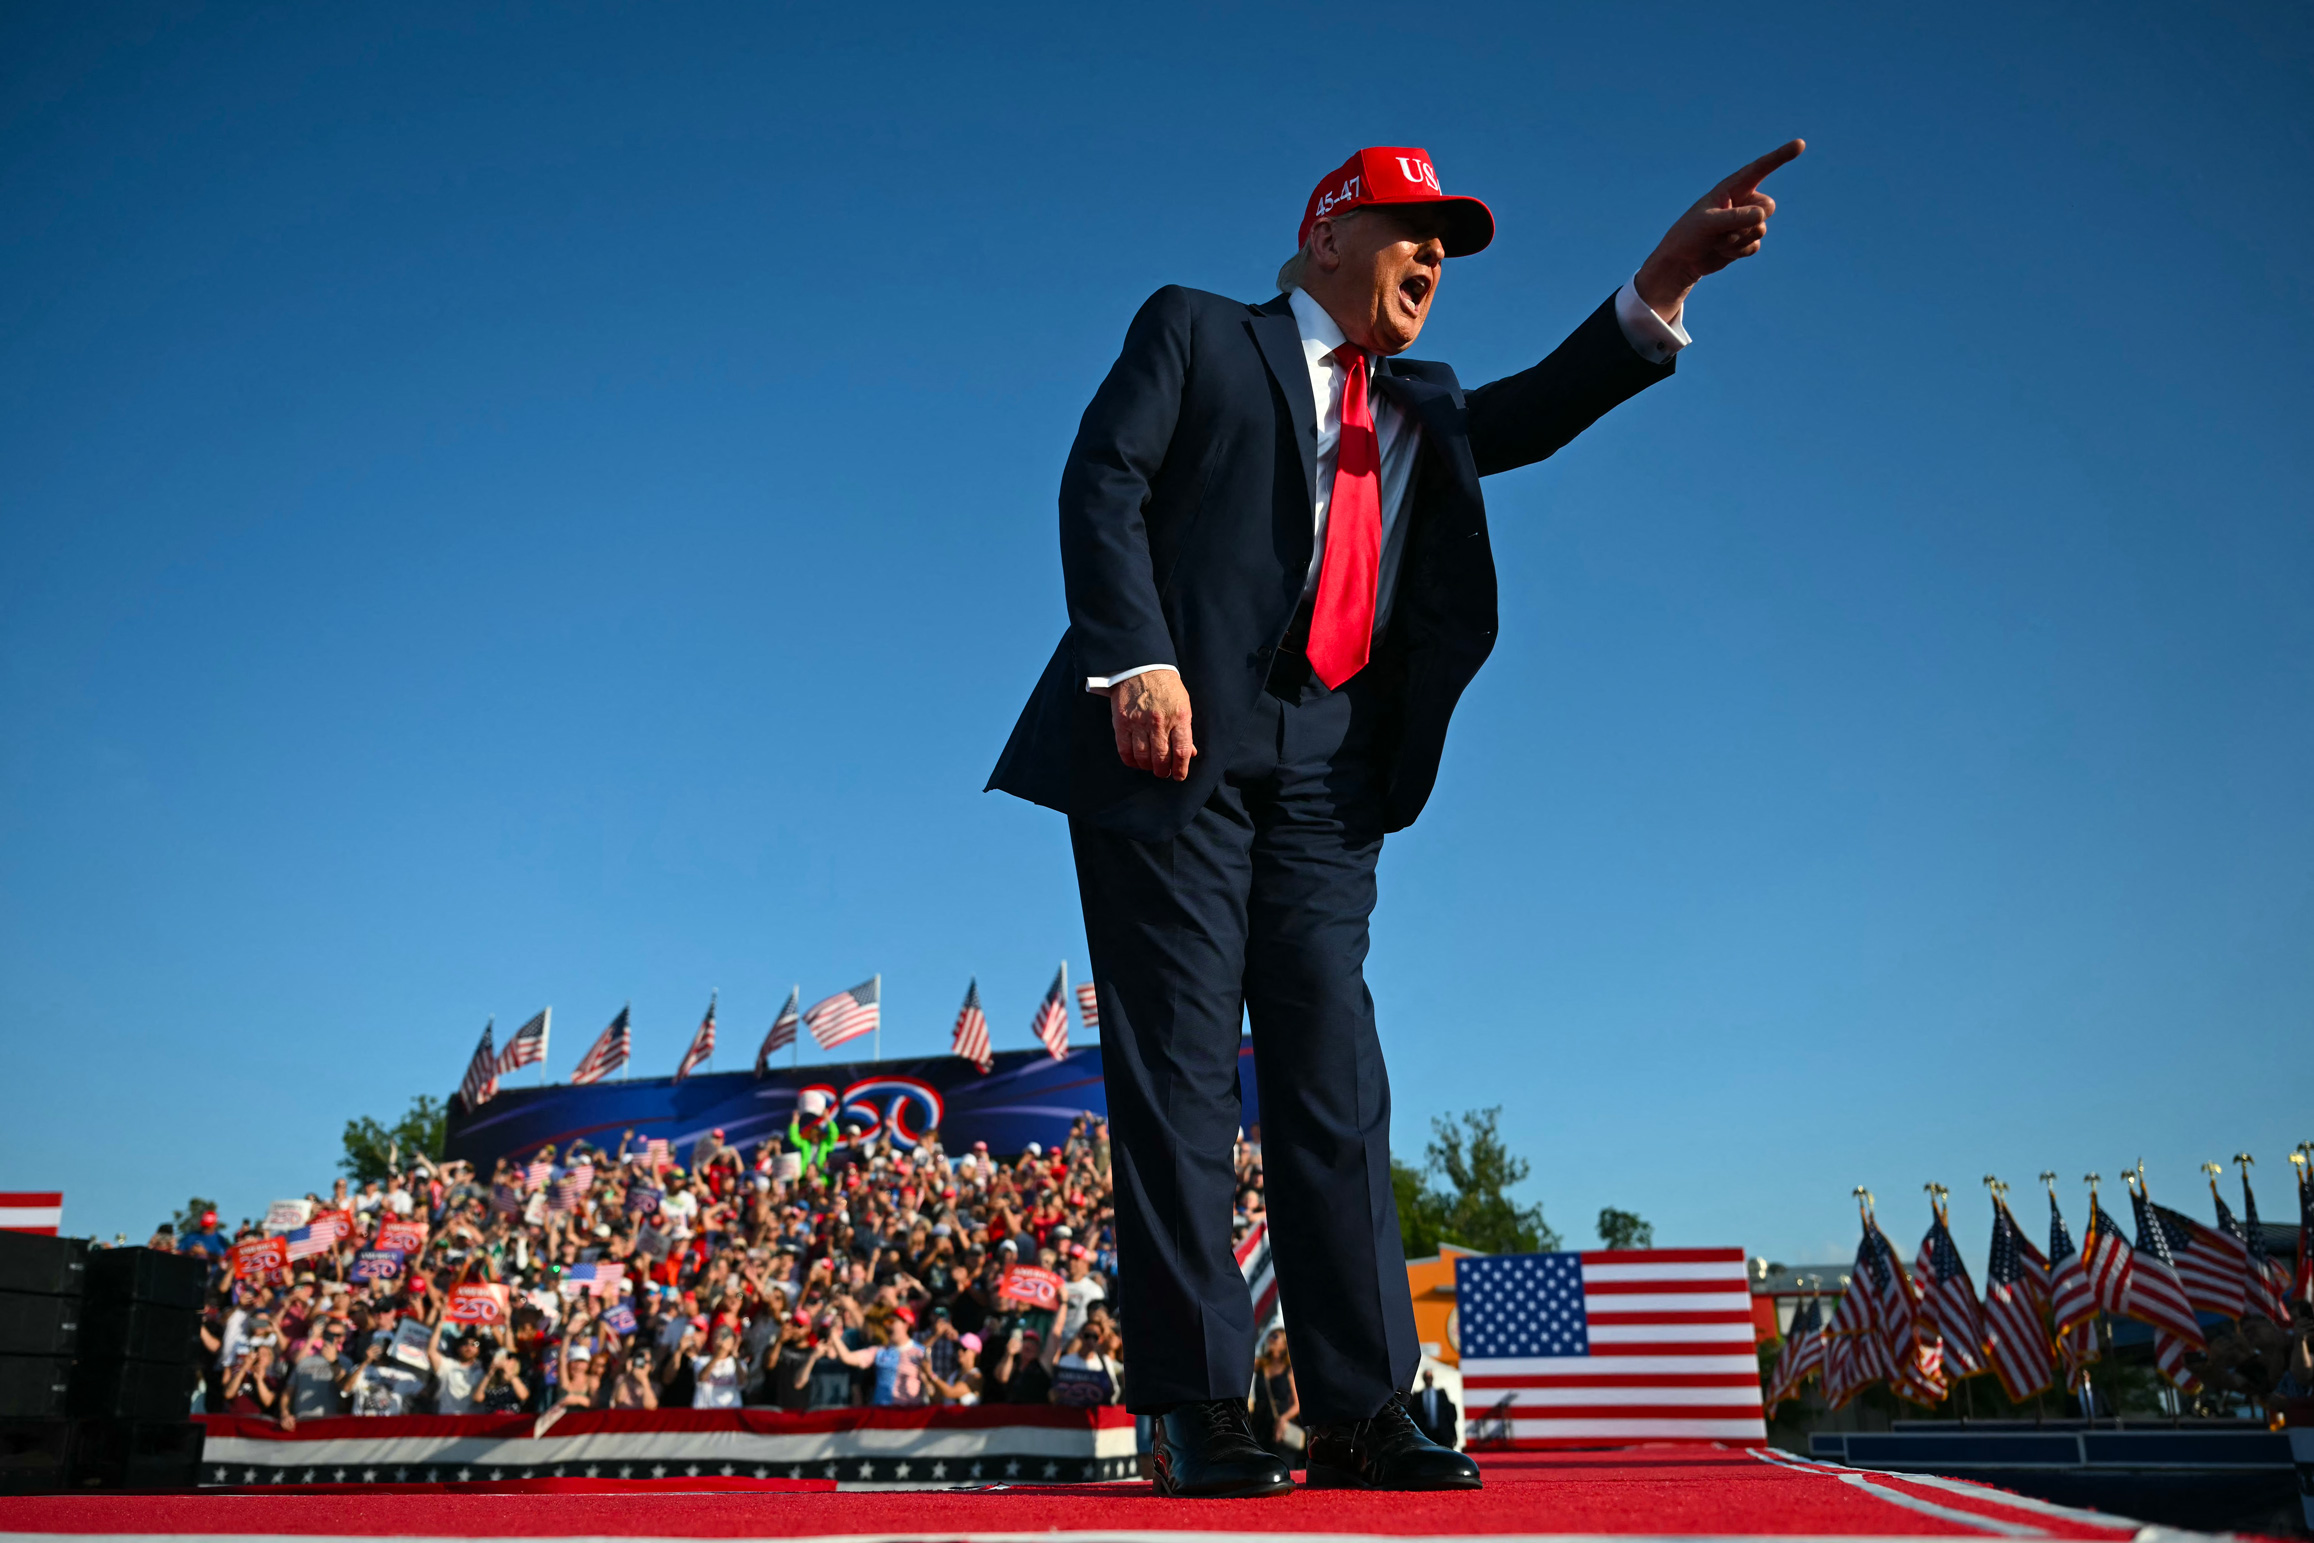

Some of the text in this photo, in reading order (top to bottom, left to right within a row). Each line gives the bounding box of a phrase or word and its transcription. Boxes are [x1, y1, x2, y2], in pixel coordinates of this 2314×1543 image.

[1395, 157, 1442, 196] US
[1315, 175, 1360, 217] 45-47
[382, 1231, 419, 1251] 250
[239, 1250, 281, 1274] 250
[357, 1259, 397, 1278] 250
[1008, 1275, 1056, 1303] 250
[453, 1297, 498, 1321] 250
